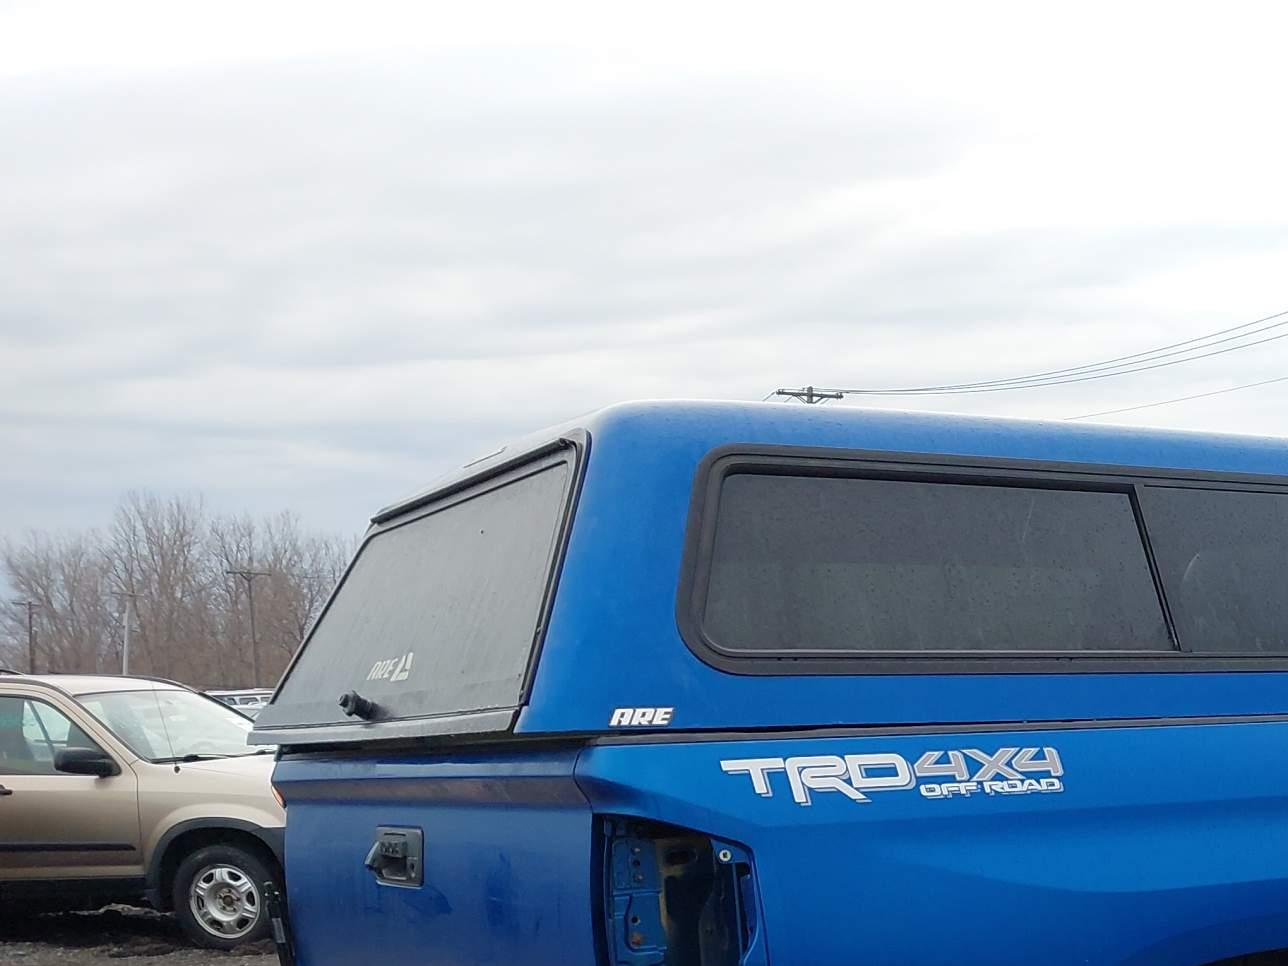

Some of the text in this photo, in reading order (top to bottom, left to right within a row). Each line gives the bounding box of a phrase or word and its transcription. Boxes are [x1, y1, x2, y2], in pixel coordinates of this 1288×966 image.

[608, 707, 674, 726] ARE
[720, 753, 916, 806] TRD
[919, 777, 1064, 799] OFF ROAD
